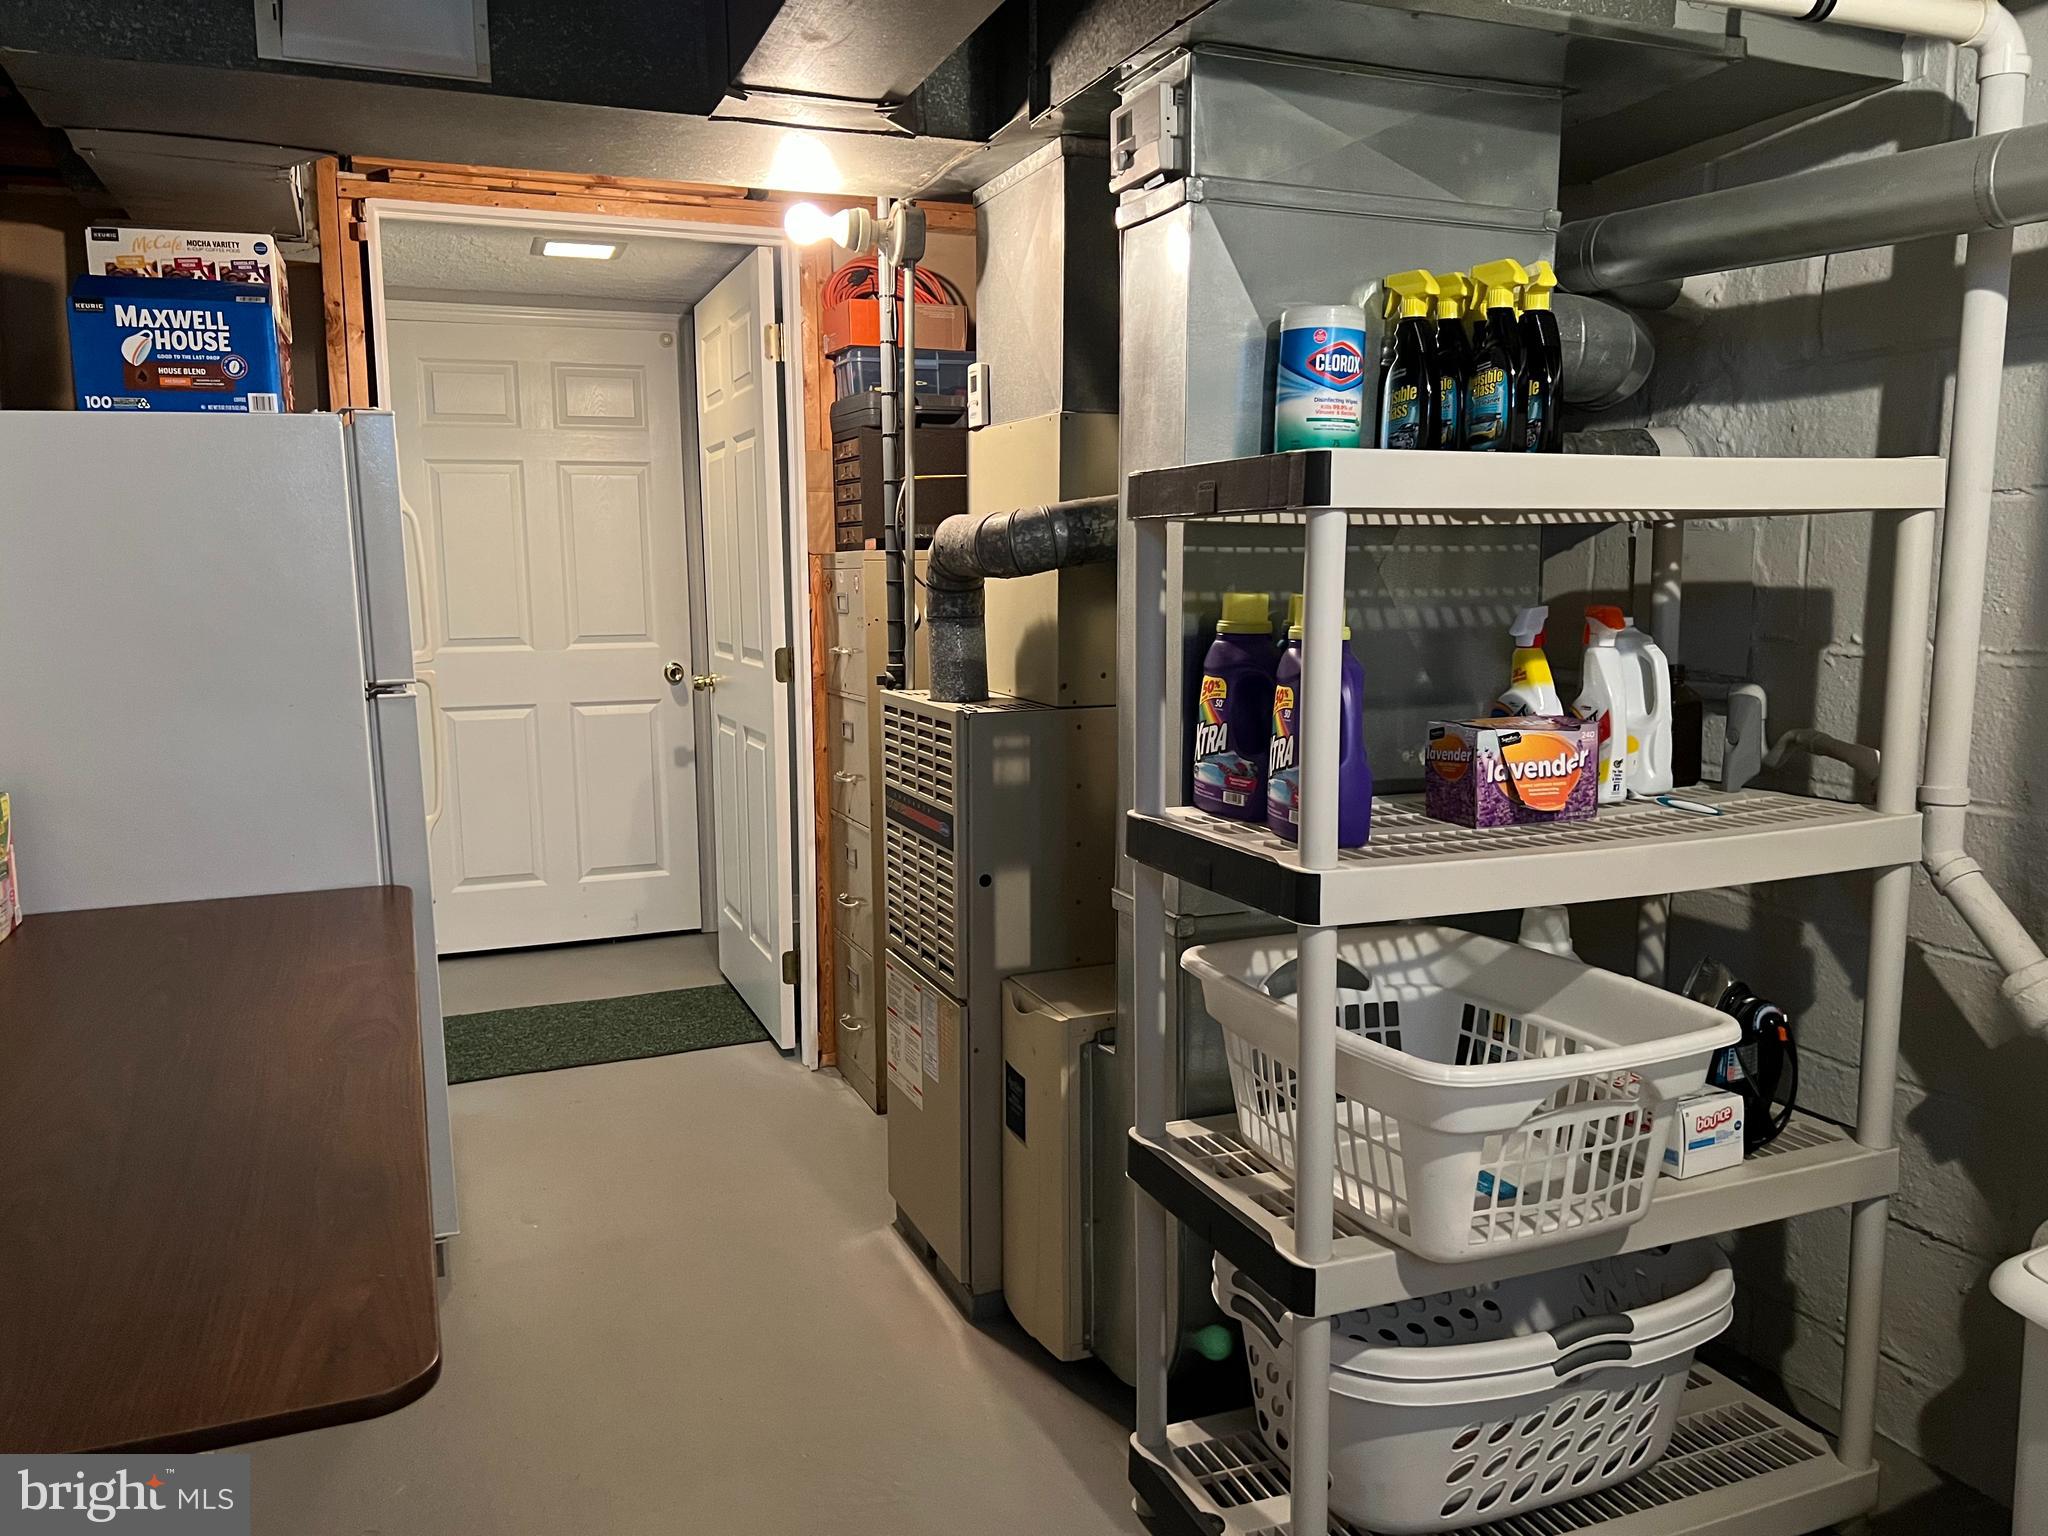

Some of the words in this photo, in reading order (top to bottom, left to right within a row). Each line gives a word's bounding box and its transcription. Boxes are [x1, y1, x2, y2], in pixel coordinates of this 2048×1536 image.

[186, 239, 211, 248] MOCHA
[212, 241, 240, 250] VARIETY
[75, 302, 104, 310] KEURIG
[114, 304, 230, 331] MAXWELL
[154, 330, 232, 352] HOUSE
[158, 367, 182, 375] HOUSE
[183, 368, 206, 376] BLEND
[1315, 353, 1361, 374] CLOROX
[84, 395, 112, 409] 100
[1391, 384, 1418, 404] isible
[1195, 721, 1228, 761] XTRA
[1581, 731, 1595, 739] 240
[1426, 746, 1473, 763] lavender
[1486, 748, 1590, 784] lavender
[1696, 1106, 1732, 1134] bounce
